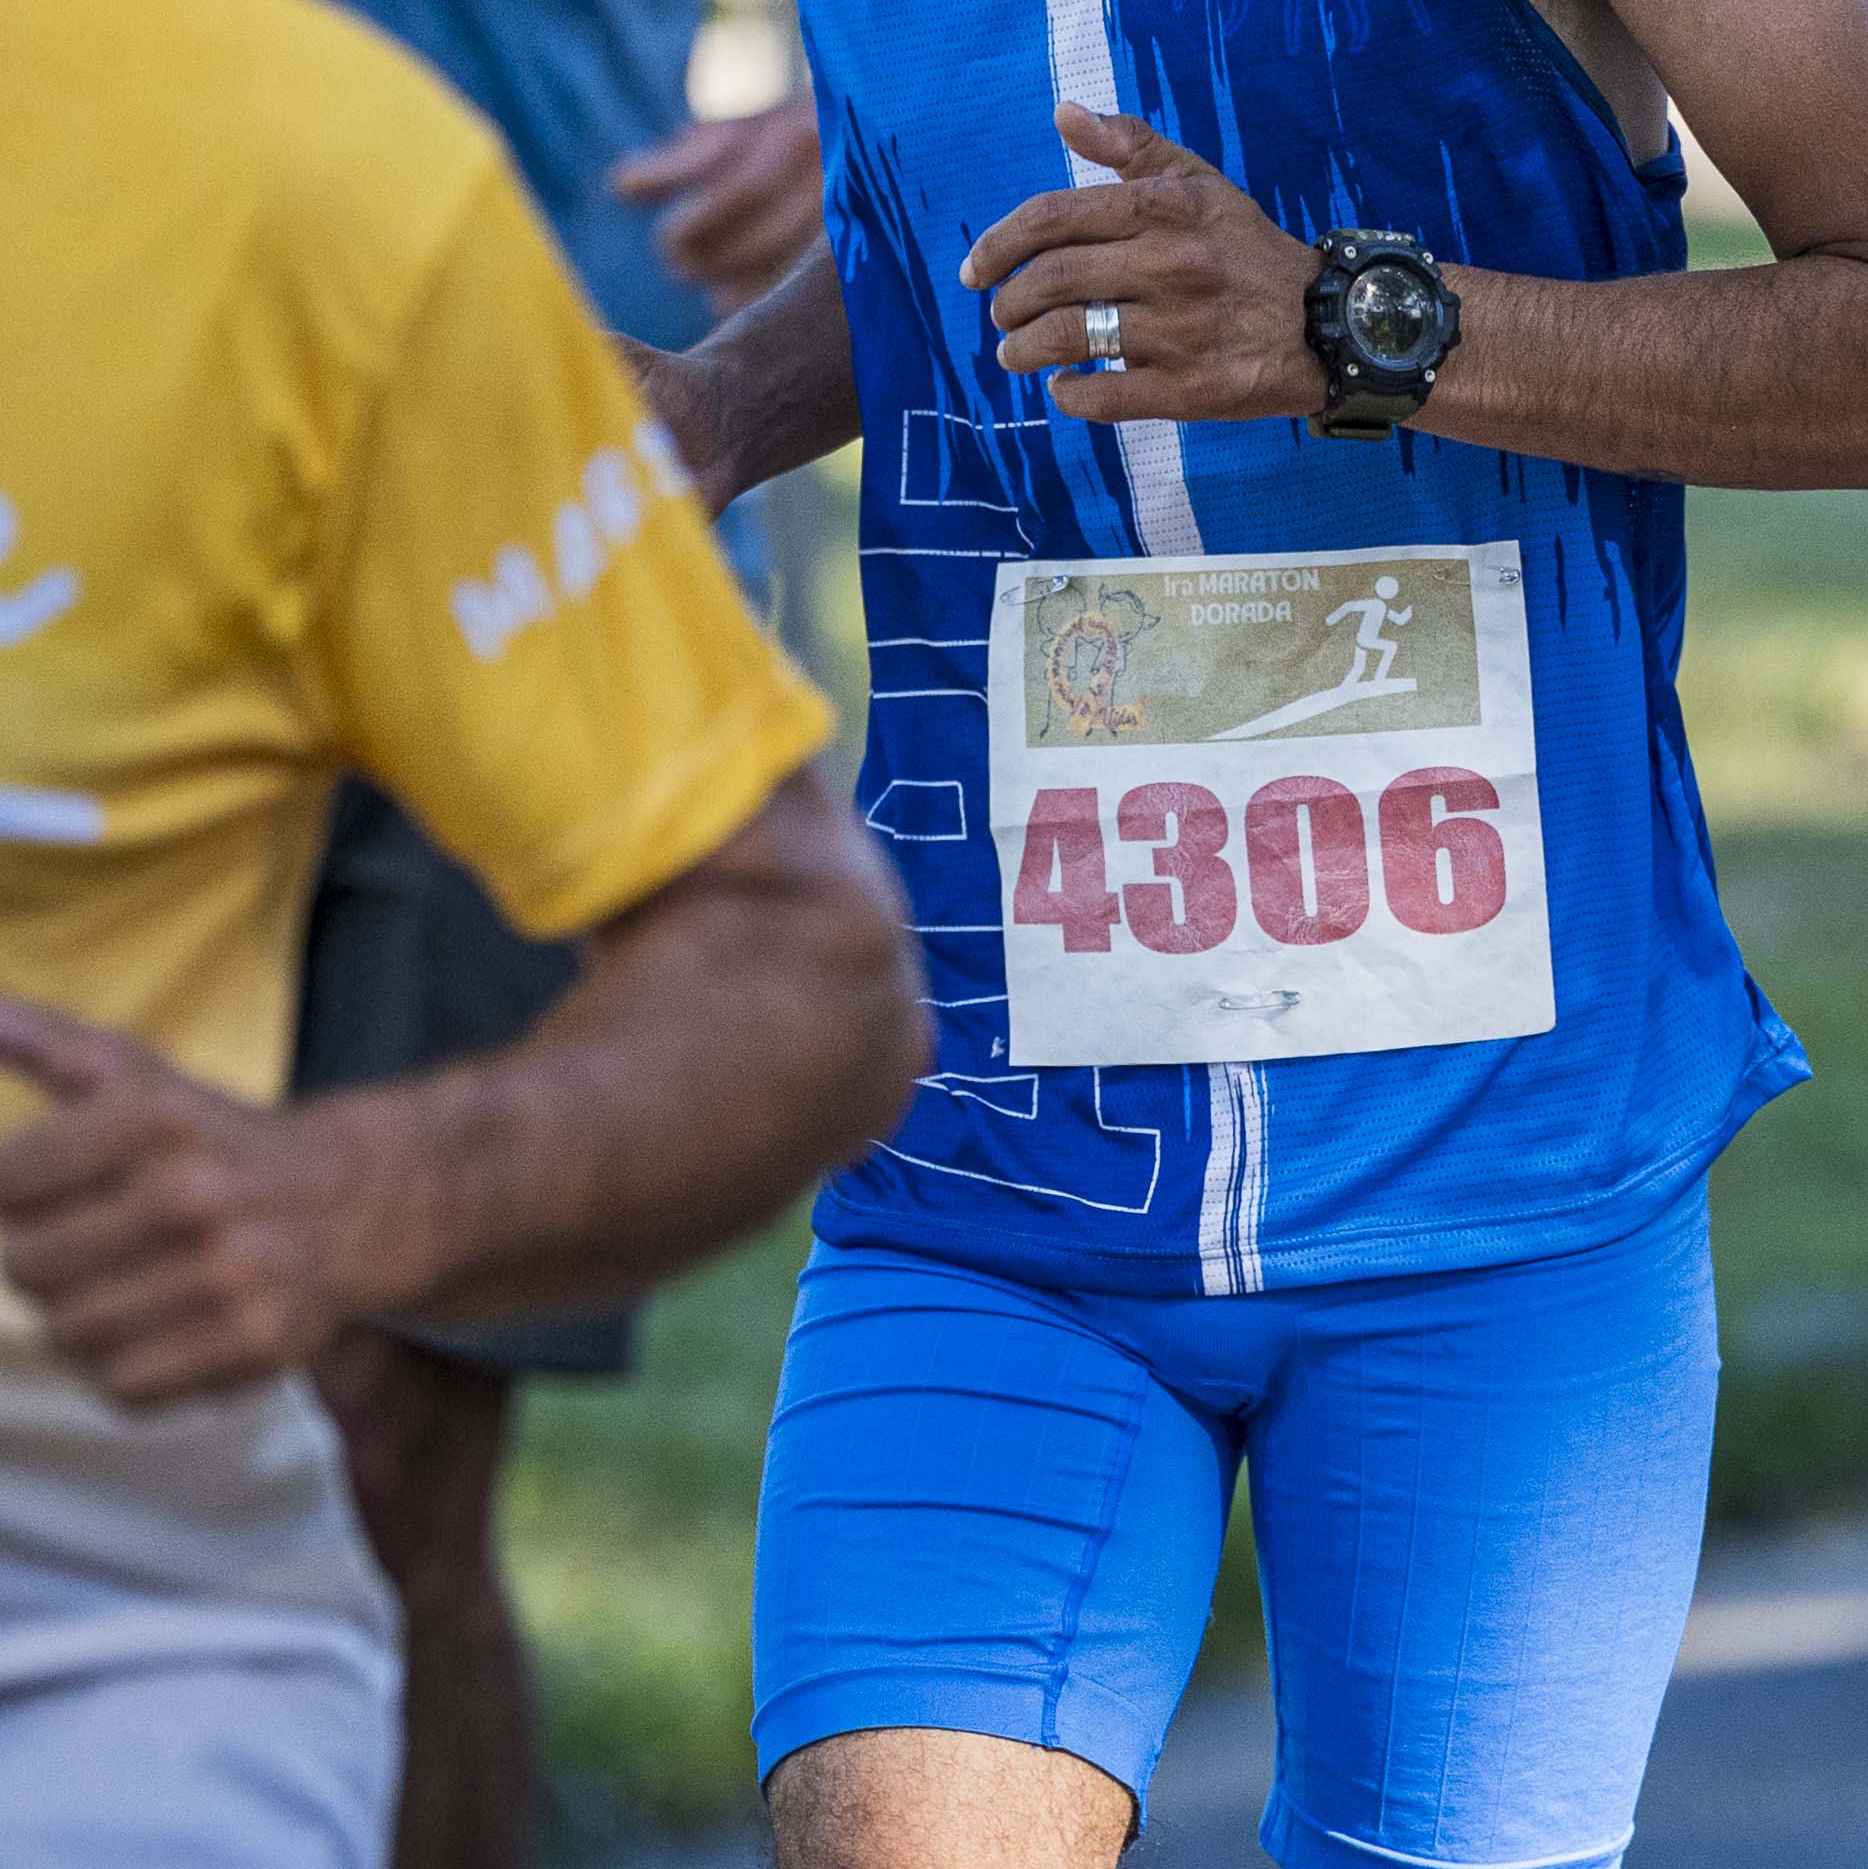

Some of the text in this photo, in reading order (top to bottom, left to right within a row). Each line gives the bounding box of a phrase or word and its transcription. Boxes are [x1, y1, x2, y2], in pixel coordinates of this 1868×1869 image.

[1199, 568, 1321, 595] MARATON
[1190, 600, 1293, 627] DORADA
[1012, 765, 1506, 955] 4306
